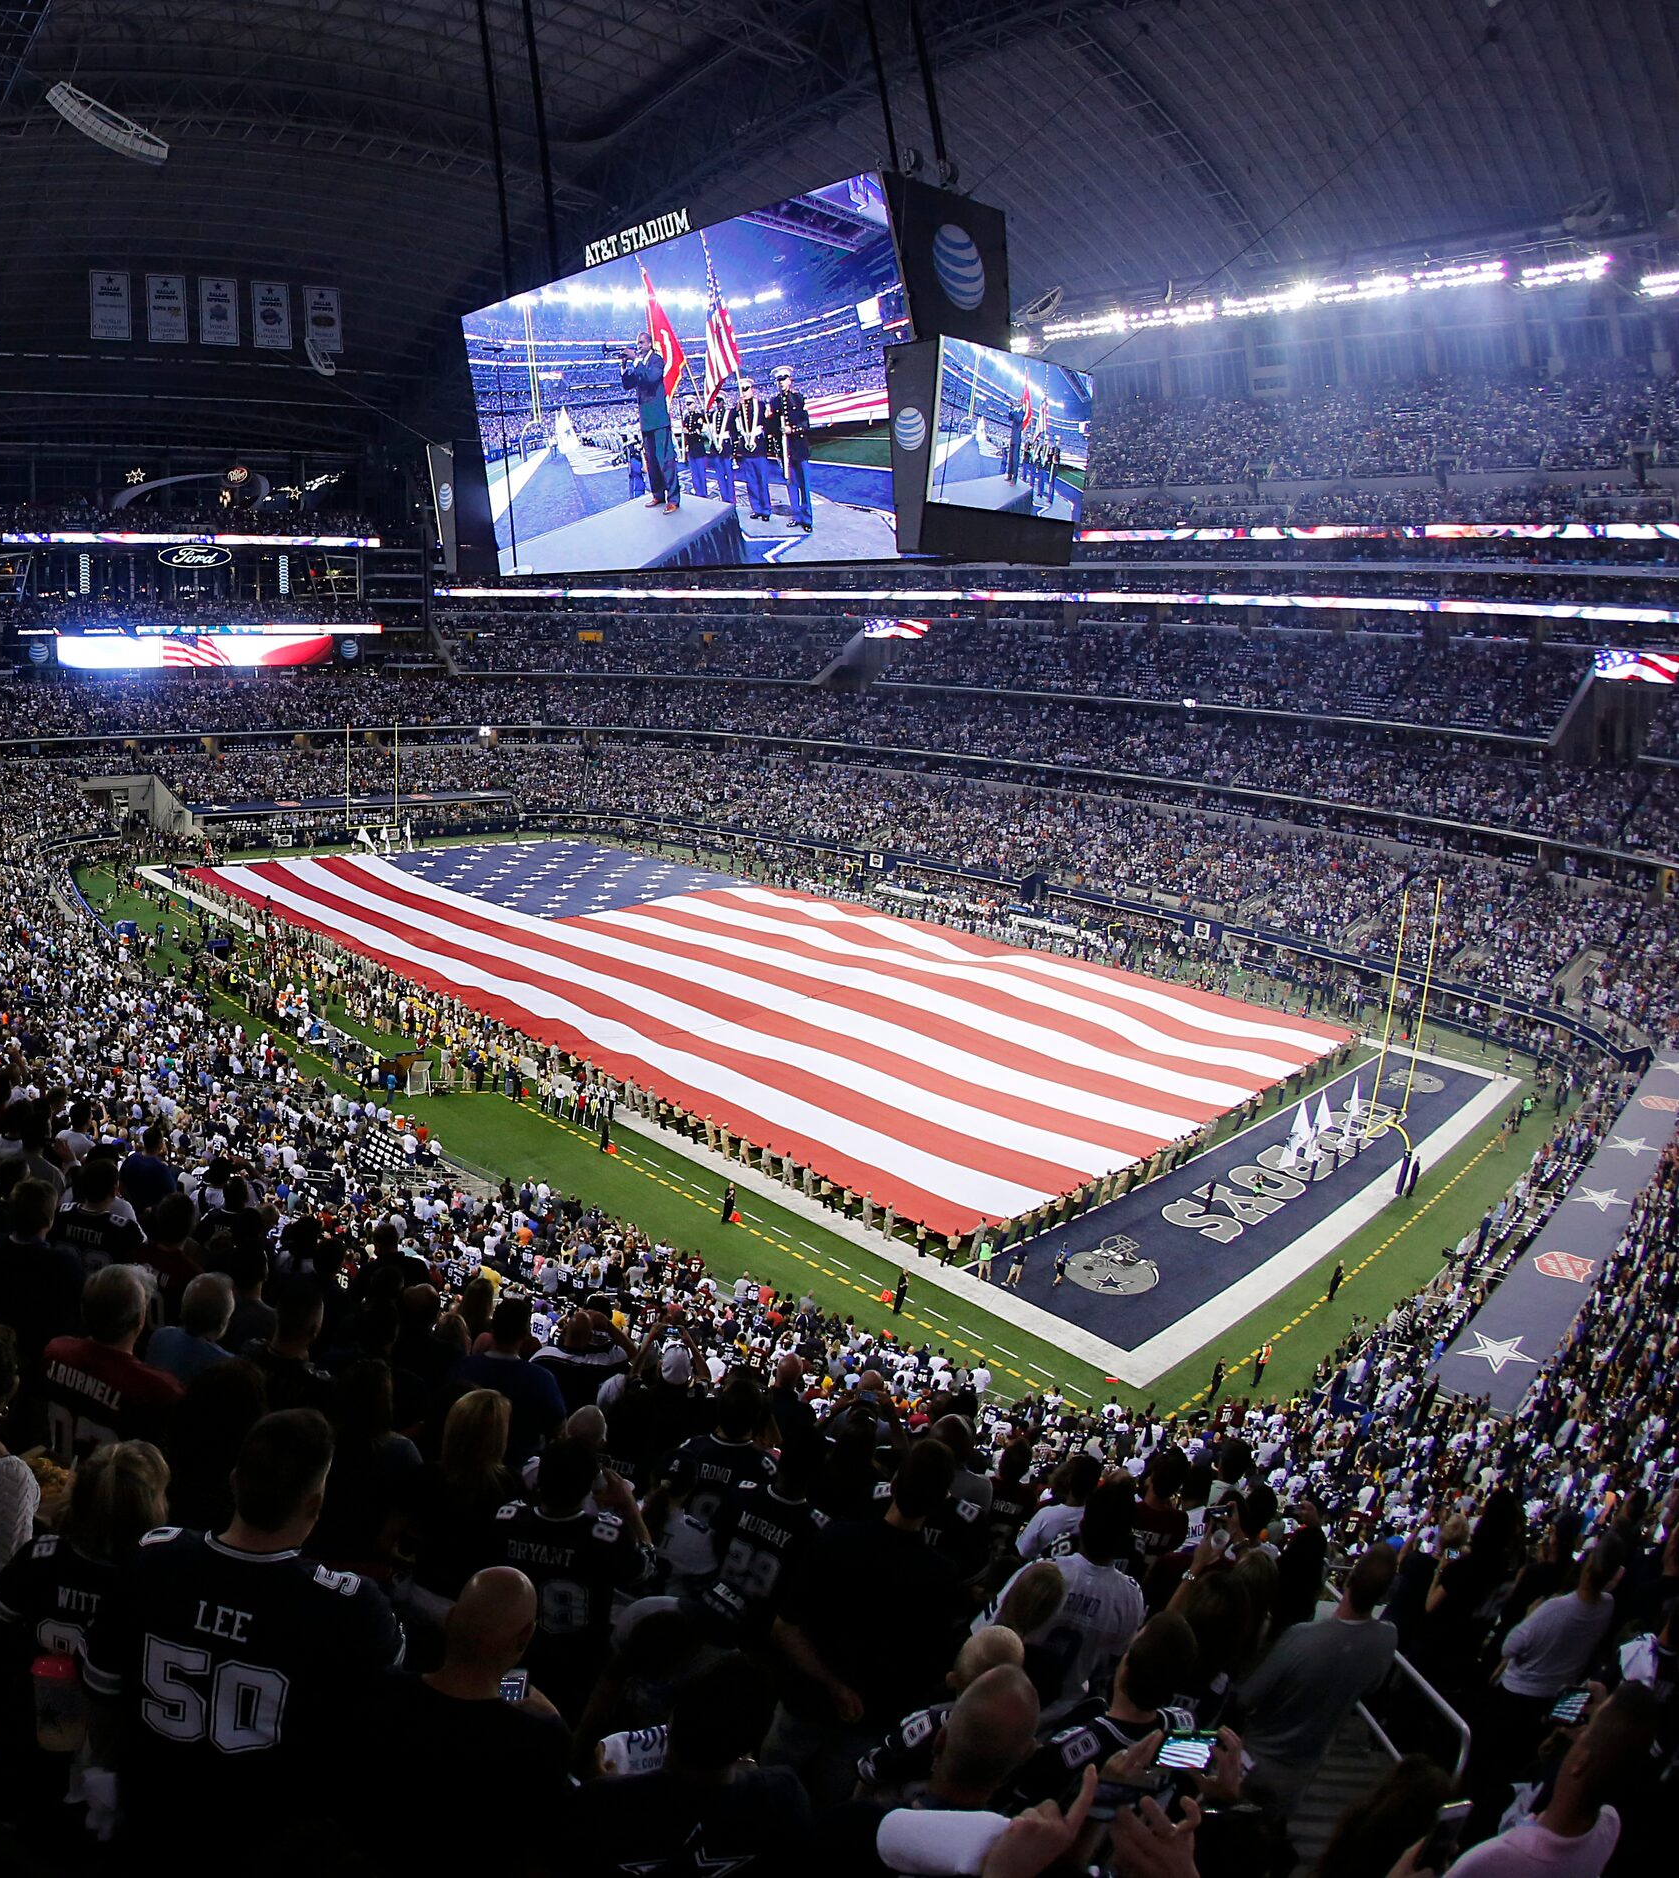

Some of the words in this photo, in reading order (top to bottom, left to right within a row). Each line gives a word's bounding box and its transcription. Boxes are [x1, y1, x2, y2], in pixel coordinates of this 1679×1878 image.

[585, 235, 618, 268] AT&T
[620, 207, 690, 254] STADIUM
[172, 548, 218, 564] Ford
[514, 1218, 520, 1227] 9
[65, 1223, 104, 1246] WITTEN
[522, 1252, 533, 1263] 82
[690, 1263, 700, 1273] 47
[452, 1274, 463, 1287] 33
[572, 1278, 584, 1290] 50
[646, 1311, 656, 1323] 10
[532, 1322, 544, 1336] 82
[750, 1355, 761, 1368] 21
[46, 1360, 122, 1411] J.BURNELL
[984, 1413, 997, 1425] 82
[1221, 1412, 1231, 1423] 10
[700, 1461, 732, 1484] ROMO
[761, 1456, 778, 1475] 9
[138, 1526, 184, 1548] 0
[737, 1510, 793, 1549] MURRAY
[506, 1539, 576, 1568] BRYANT
[312, 1563, 361, 1597] 5
[1064, 1593, 1102, 1618] ROMO
[193, 1600, 253, 1645] LEE
[140, 1632, 293, 1756] 50
